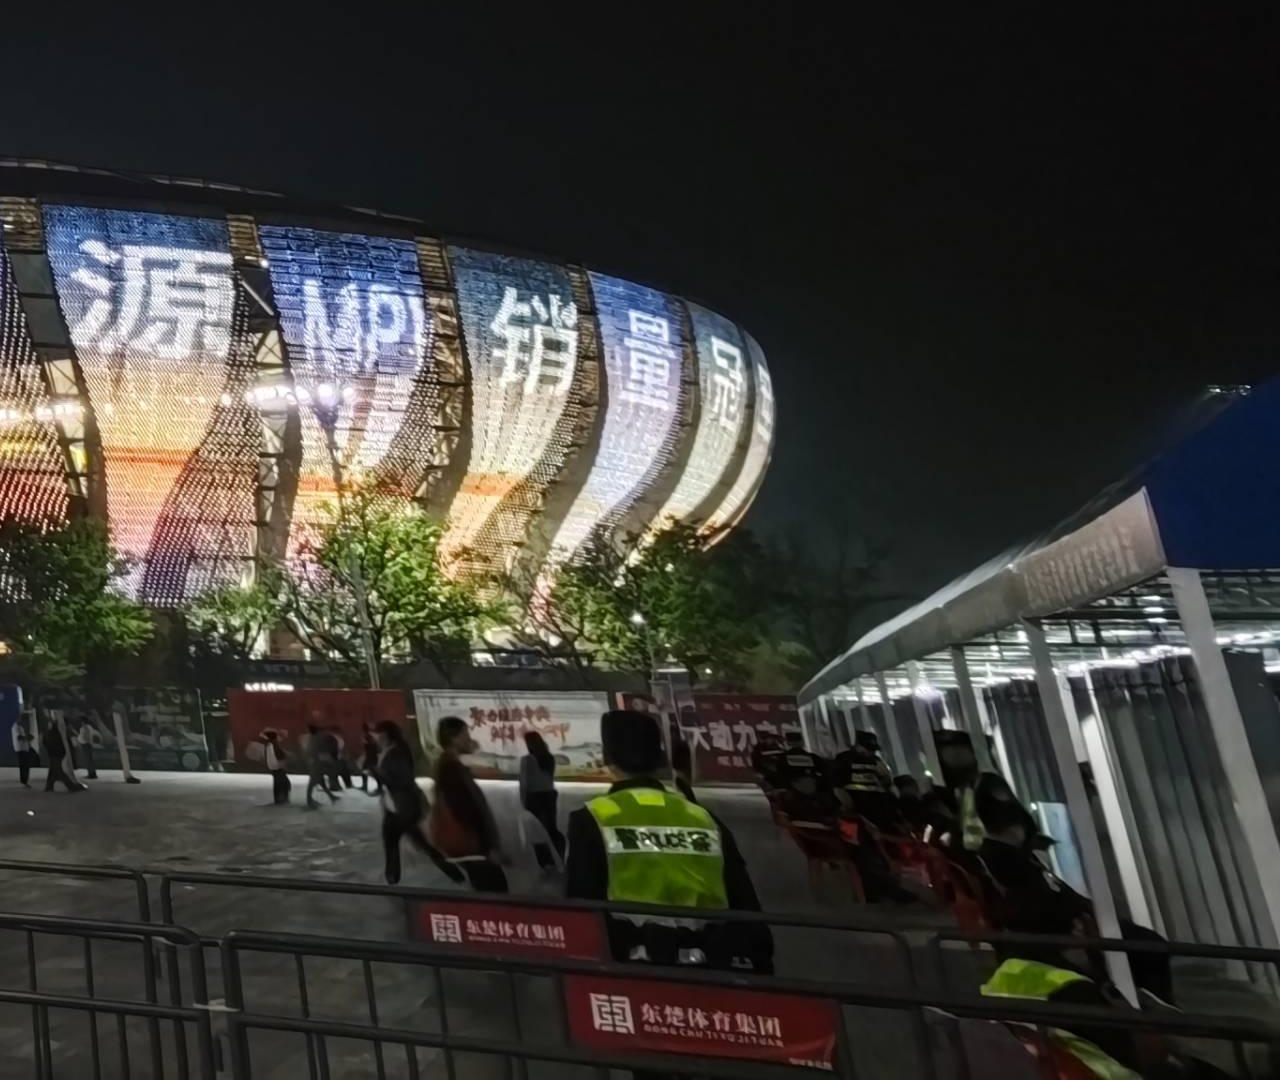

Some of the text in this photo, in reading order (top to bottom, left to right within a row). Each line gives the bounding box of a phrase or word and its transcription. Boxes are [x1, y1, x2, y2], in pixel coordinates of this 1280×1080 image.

[466, 919, 566, 941] 东楚体育集团
[640, 1002, 782, 1037] 东楚体育集团
